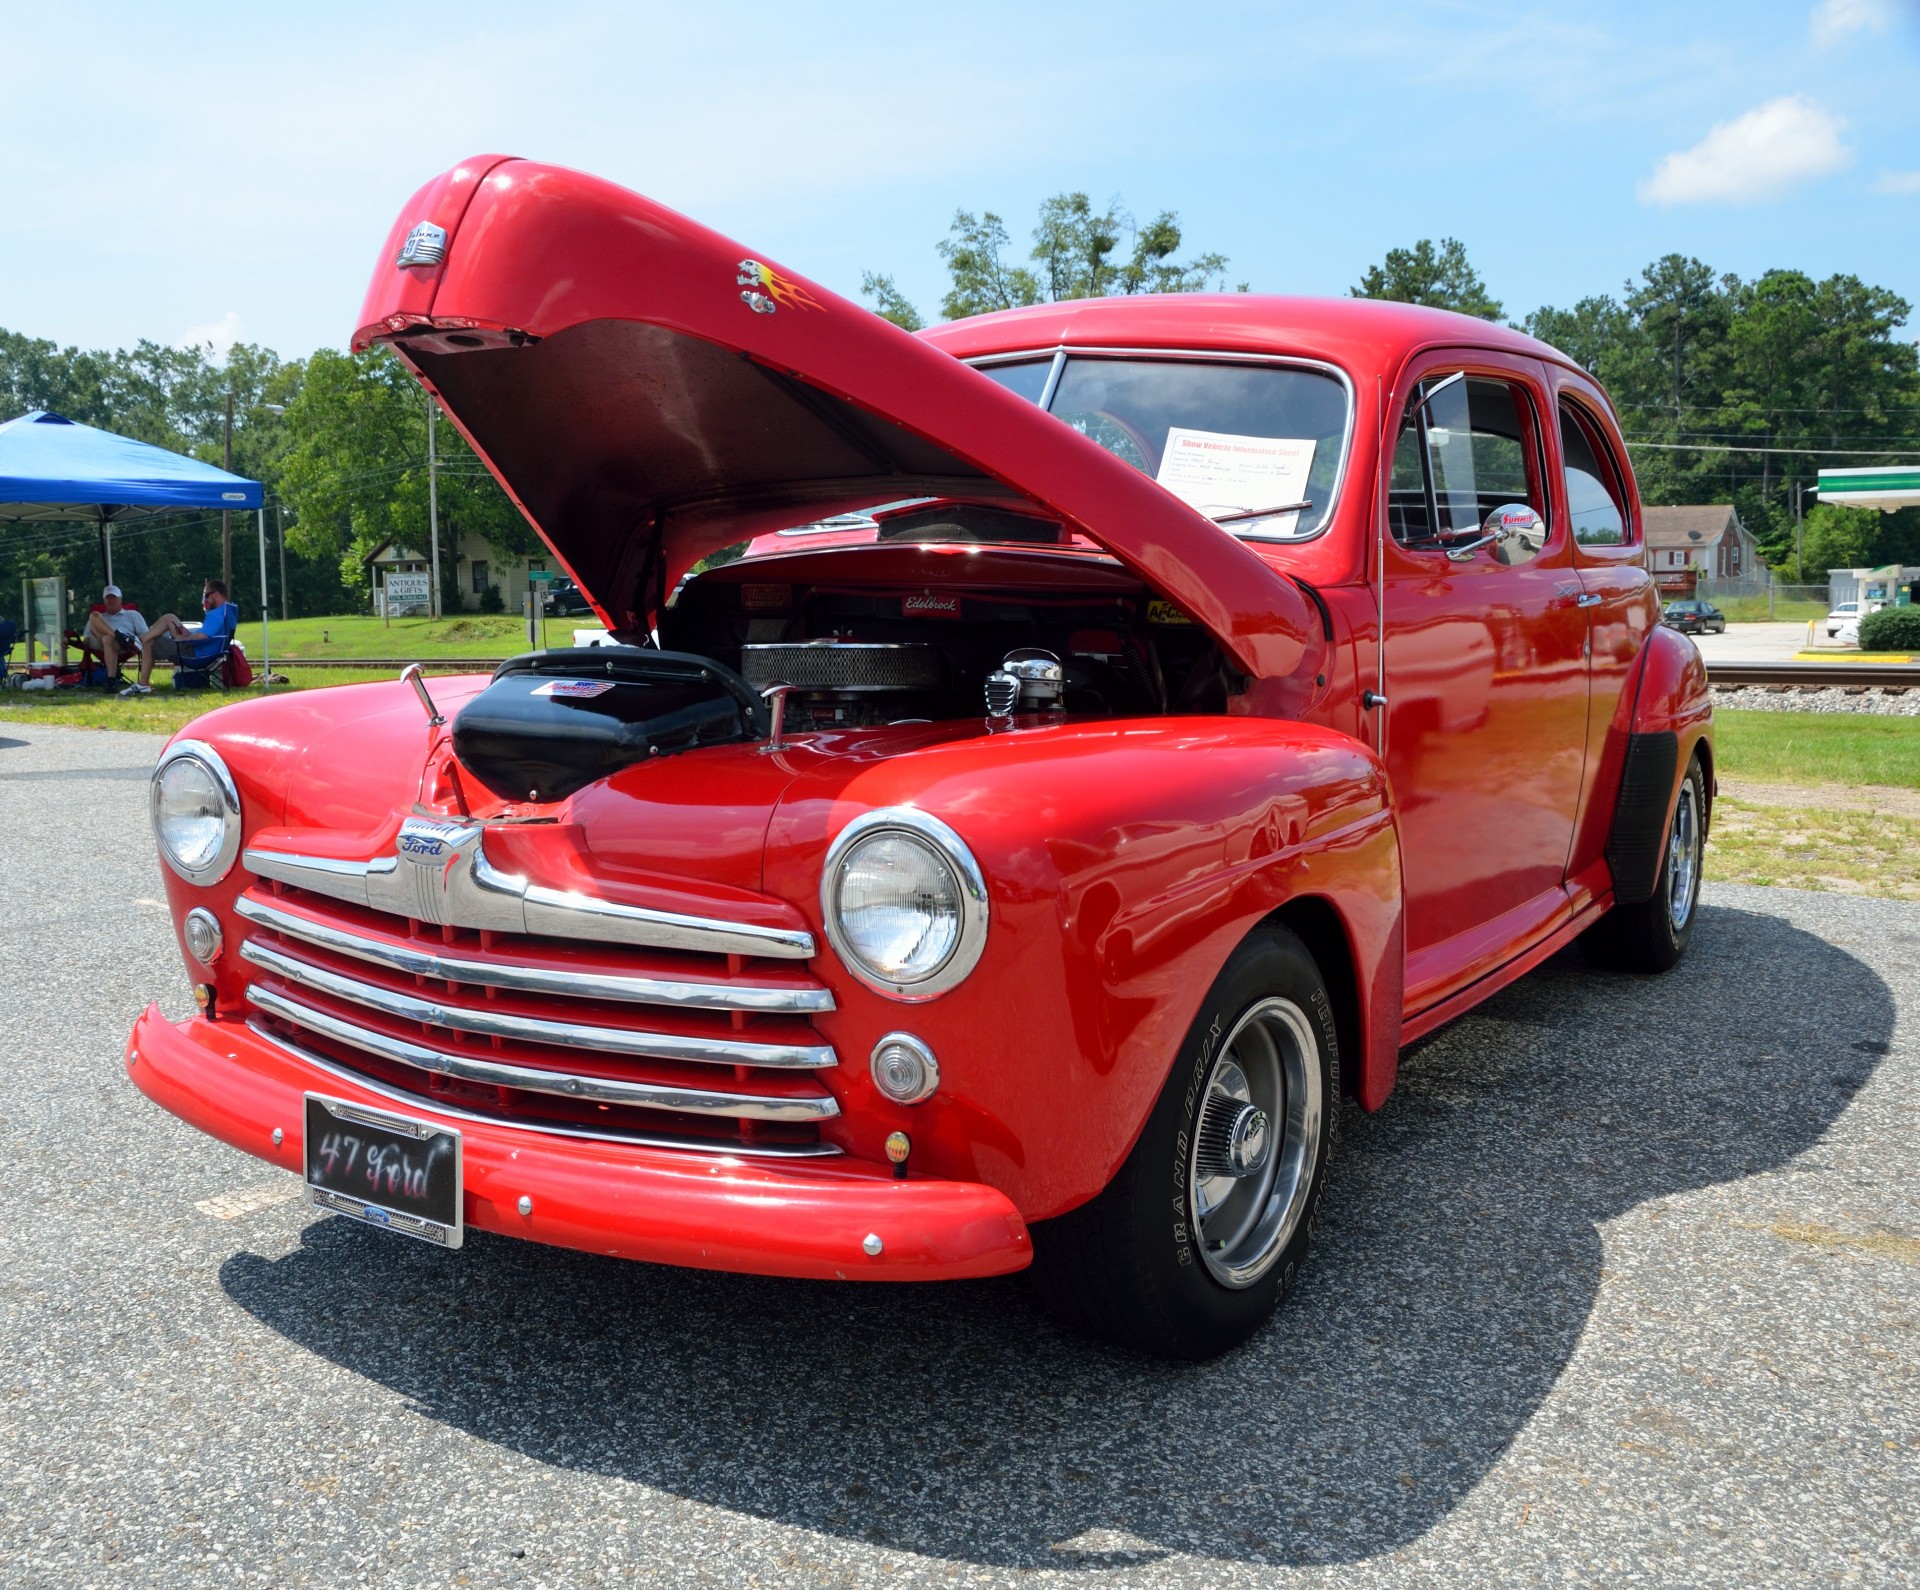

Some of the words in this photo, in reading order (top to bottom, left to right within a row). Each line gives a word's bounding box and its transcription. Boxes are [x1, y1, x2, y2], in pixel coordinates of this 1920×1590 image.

[1181, 439, 1202, 449] Show
[1203, 441, 1231, 452] Vehicle
[1232, 445, 1277, 456] Information
[1278, 448, 1300, 457] Sheet
[400, 586, 423, 594] GIFTS
[905, 595, 957, 611] Edelbrock
[402, 841, 443, 855] Ford
[1172, 1130, 1192, 1267] GRAND
[1184, 1013, 1223, 1120] PRIX
[320, 1132, 360, 1176] 47
[366, 1143, 437, 1200] Ford
